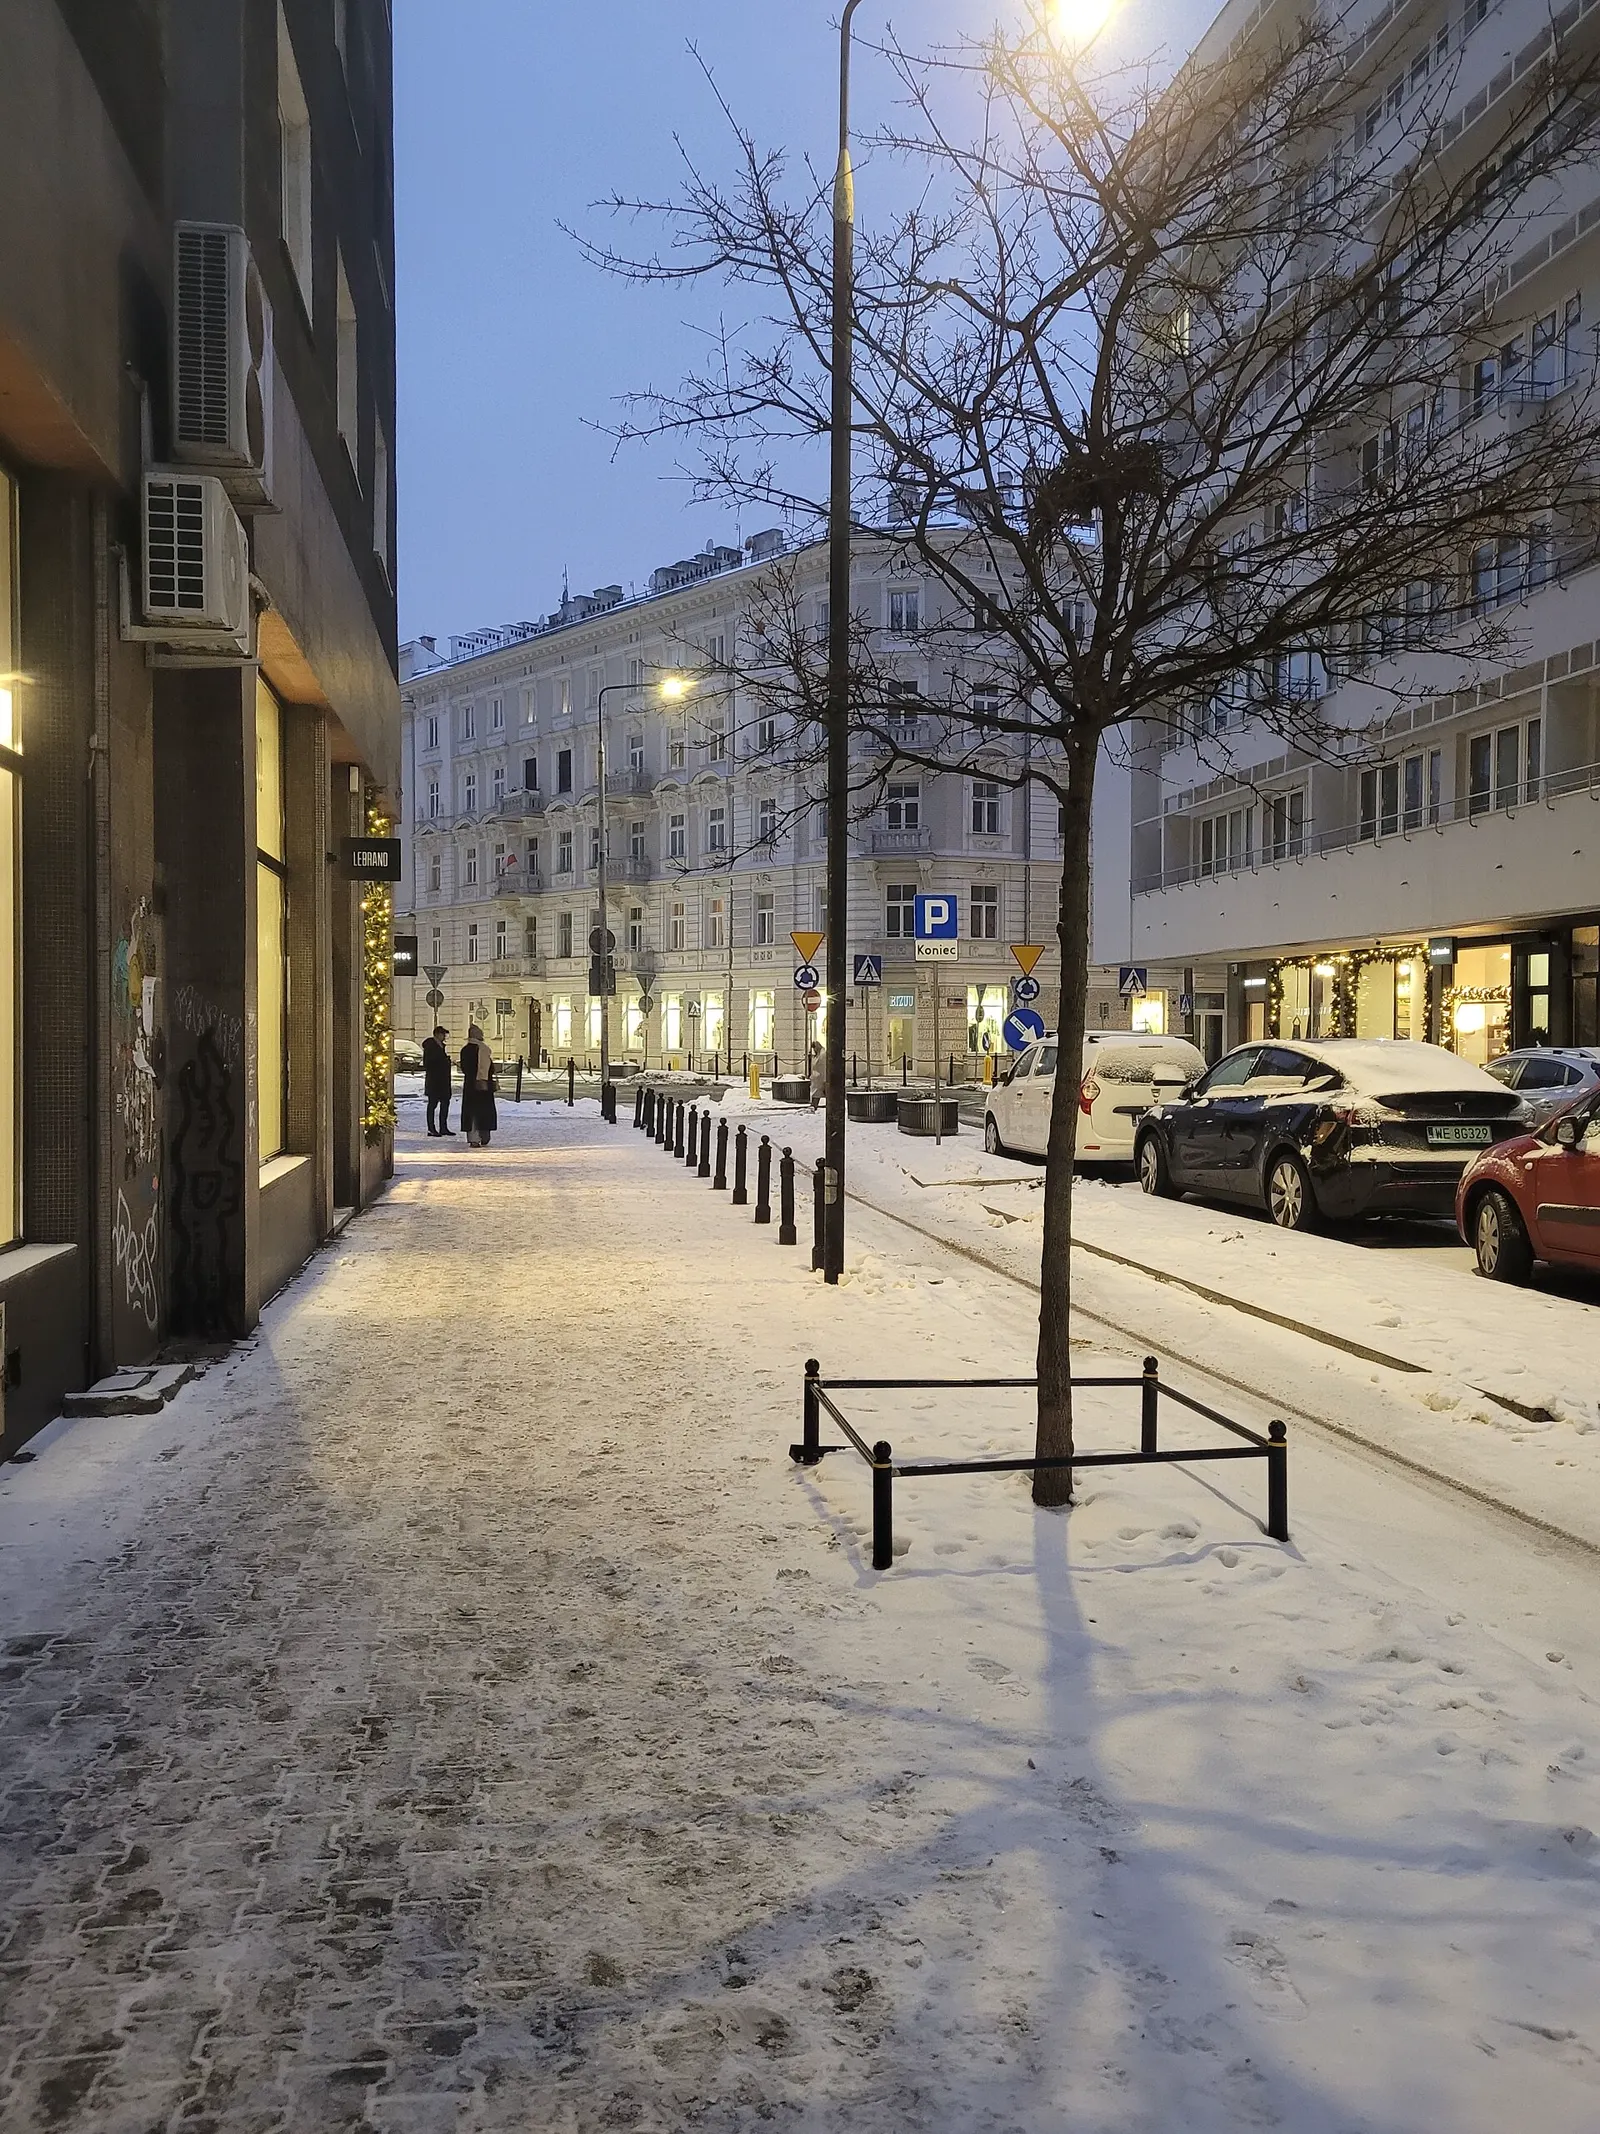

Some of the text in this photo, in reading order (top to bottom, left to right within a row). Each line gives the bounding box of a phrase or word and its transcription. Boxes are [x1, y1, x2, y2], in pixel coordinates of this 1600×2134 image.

[353, 851, 389, 867] LEBRAND
[924, 899, 949, 934] P
[917, 944, 956, 955] Koniec
[889, 995, 914, 1007] BIZUU
[1435, 1128, 1488, 1139] WE 8G329
